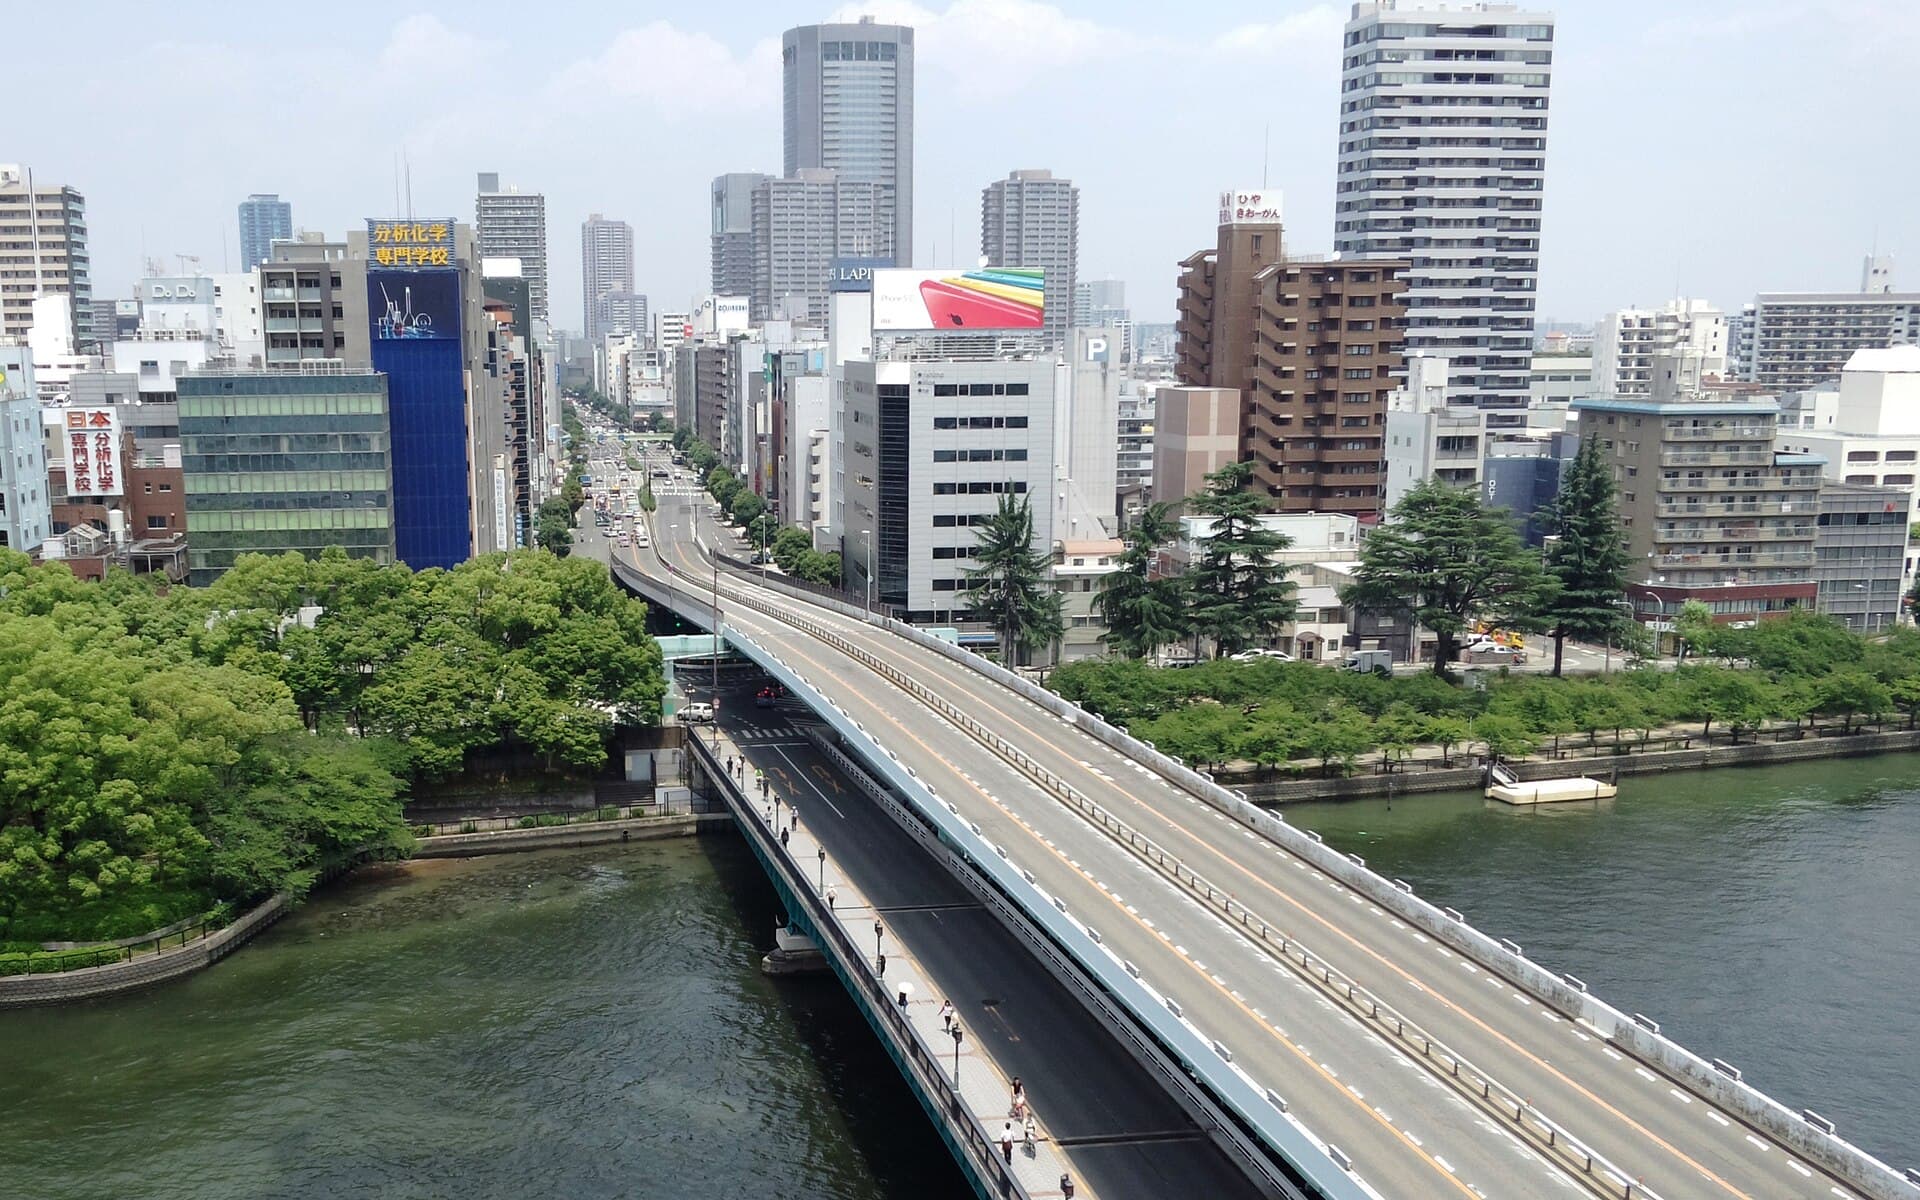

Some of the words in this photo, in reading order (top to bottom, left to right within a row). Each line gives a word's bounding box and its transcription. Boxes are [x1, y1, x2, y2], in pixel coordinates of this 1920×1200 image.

[1238, 194, 1261, 204] ひや
[375, 223, 447, 243] 分析化学
[376, 246, 449, 266] 専門学校
[1088, 338, 1107, 360] P
[67, 411, 111, 428] 日本
[70, 433, 91, 492] 専門学校
[94, 432, 114, 492] 分析化学
